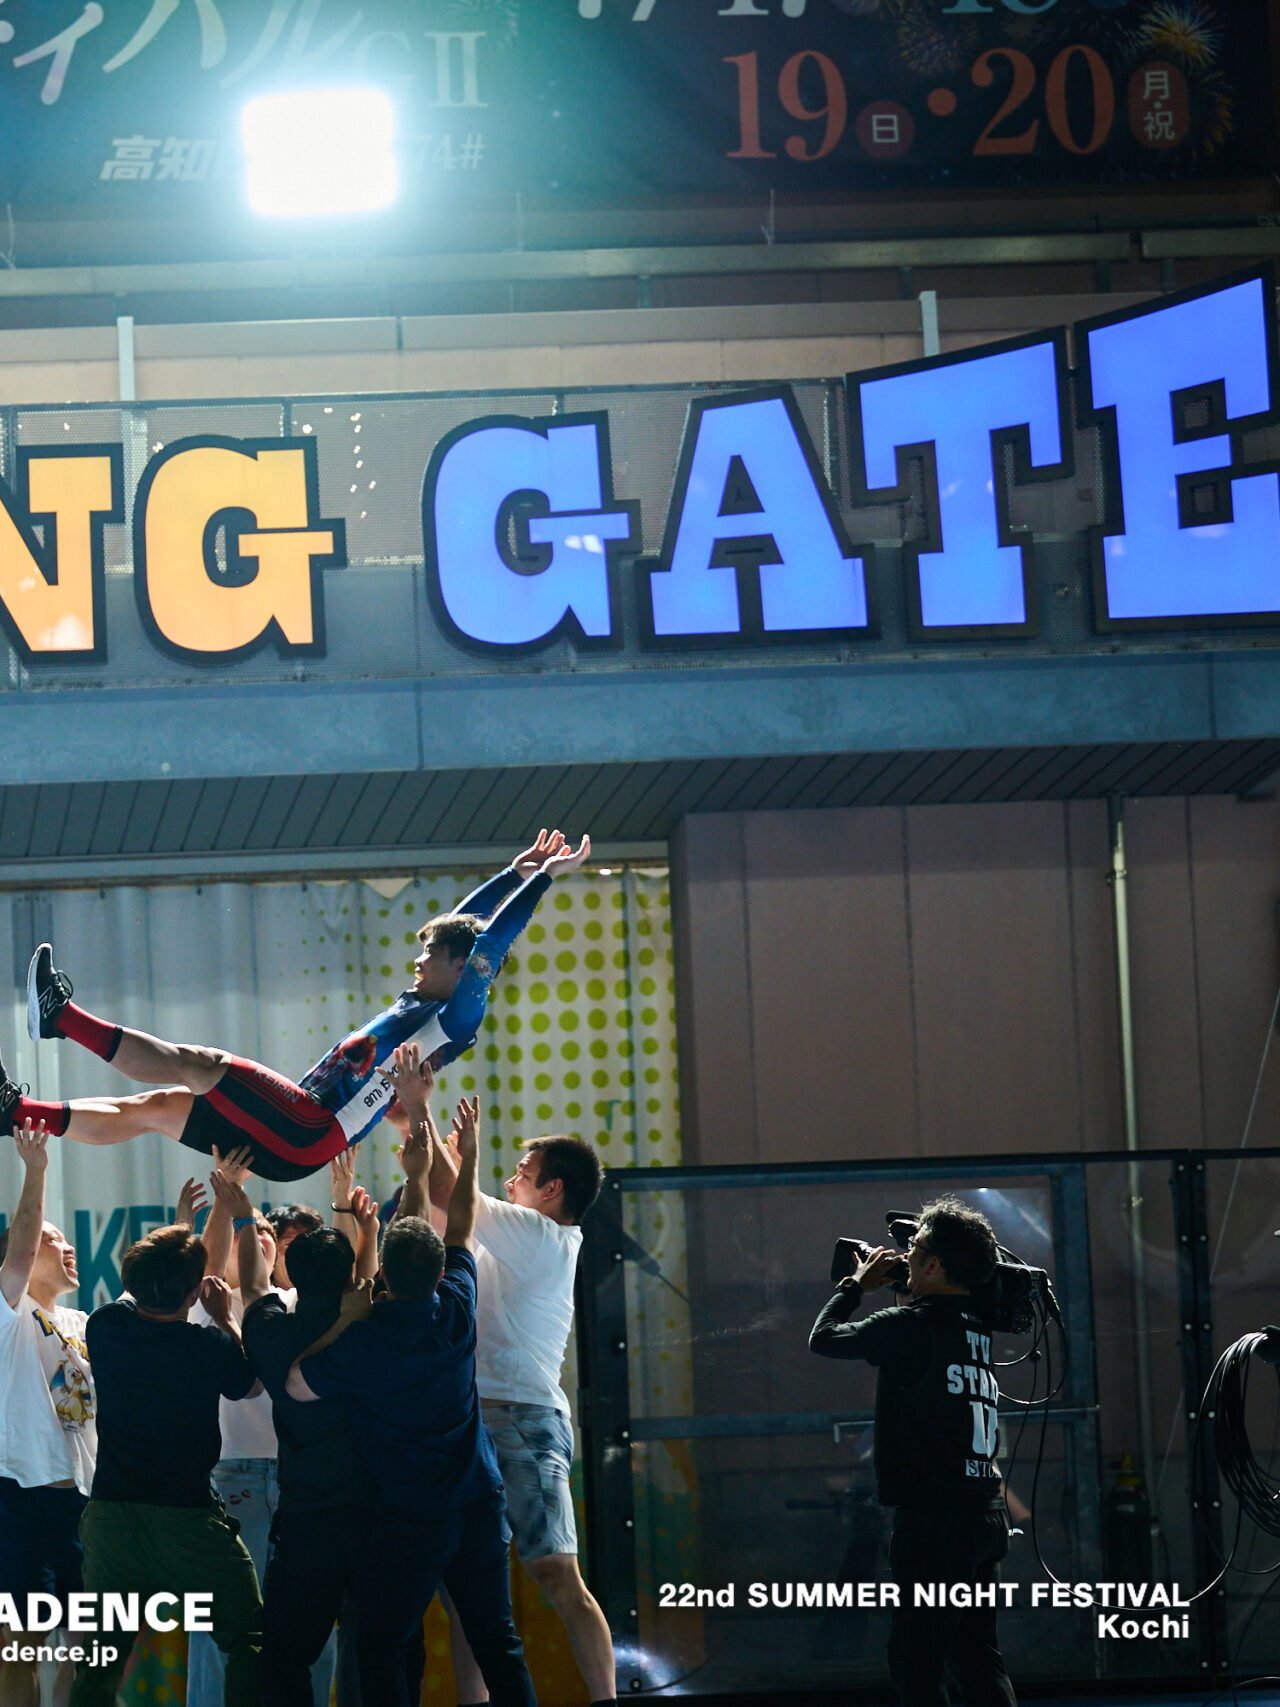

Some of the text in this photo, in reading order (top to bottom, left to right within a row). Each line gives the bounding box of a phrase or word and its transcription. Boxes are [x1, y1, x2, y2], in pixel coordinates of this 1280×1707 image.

[723, 50, 847, 161] 19
[431, 276, 1280, 647] GATE
[965, 1330, 991, 1365] TV
